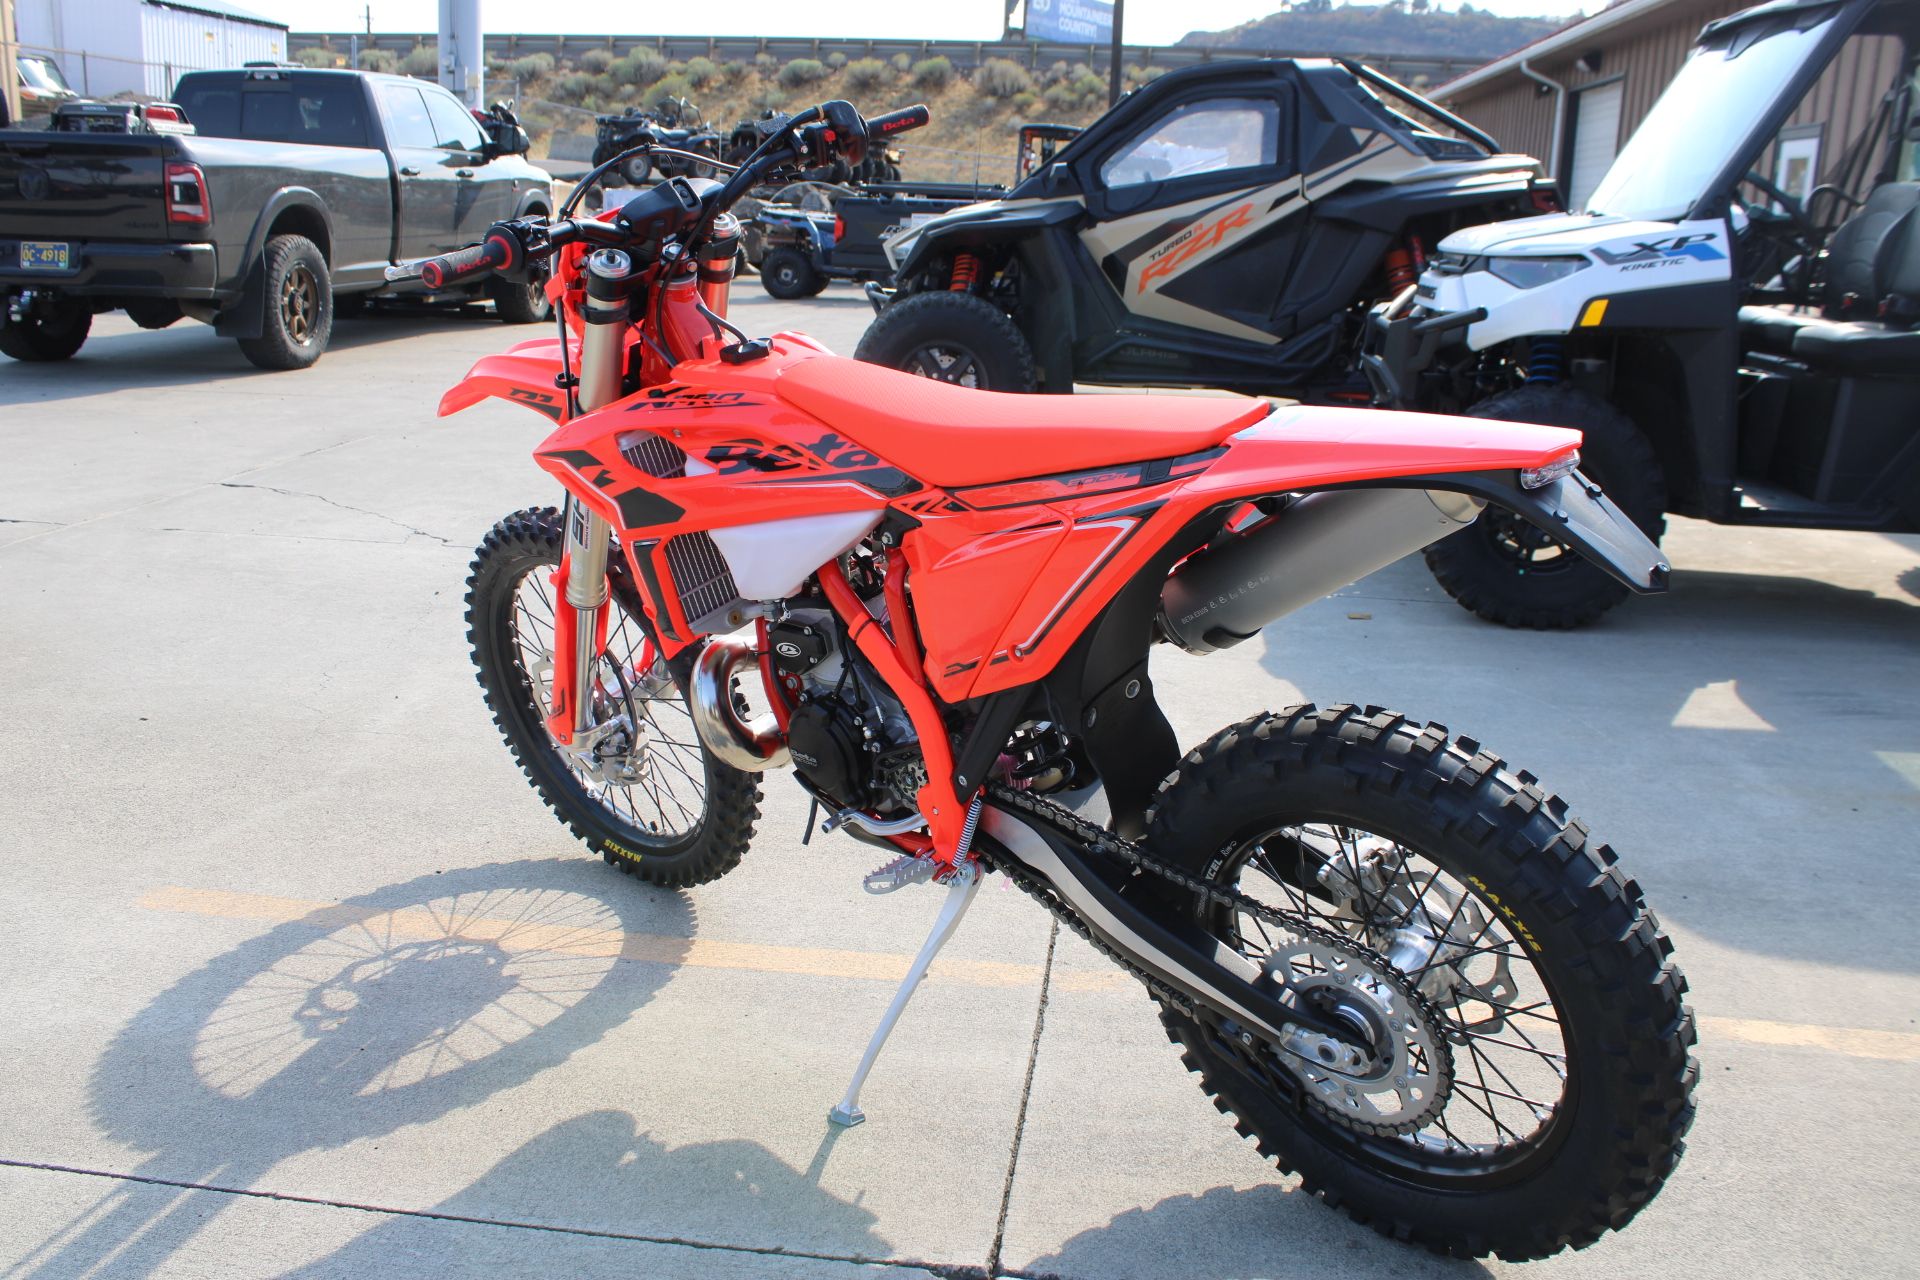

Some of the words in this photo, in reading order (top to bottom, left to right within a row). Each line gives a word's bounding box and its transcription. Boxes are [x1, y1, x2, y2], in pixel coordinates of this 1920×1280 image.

[1138, 203, 1254, 294] RZR
[1620, 258, 1686, 272] KINETIC
[705, 433, 880, 476] Beta
[604, 839, 643, 863] MAXXIS
[1467, 875, 1543, 953] MAXXIS
